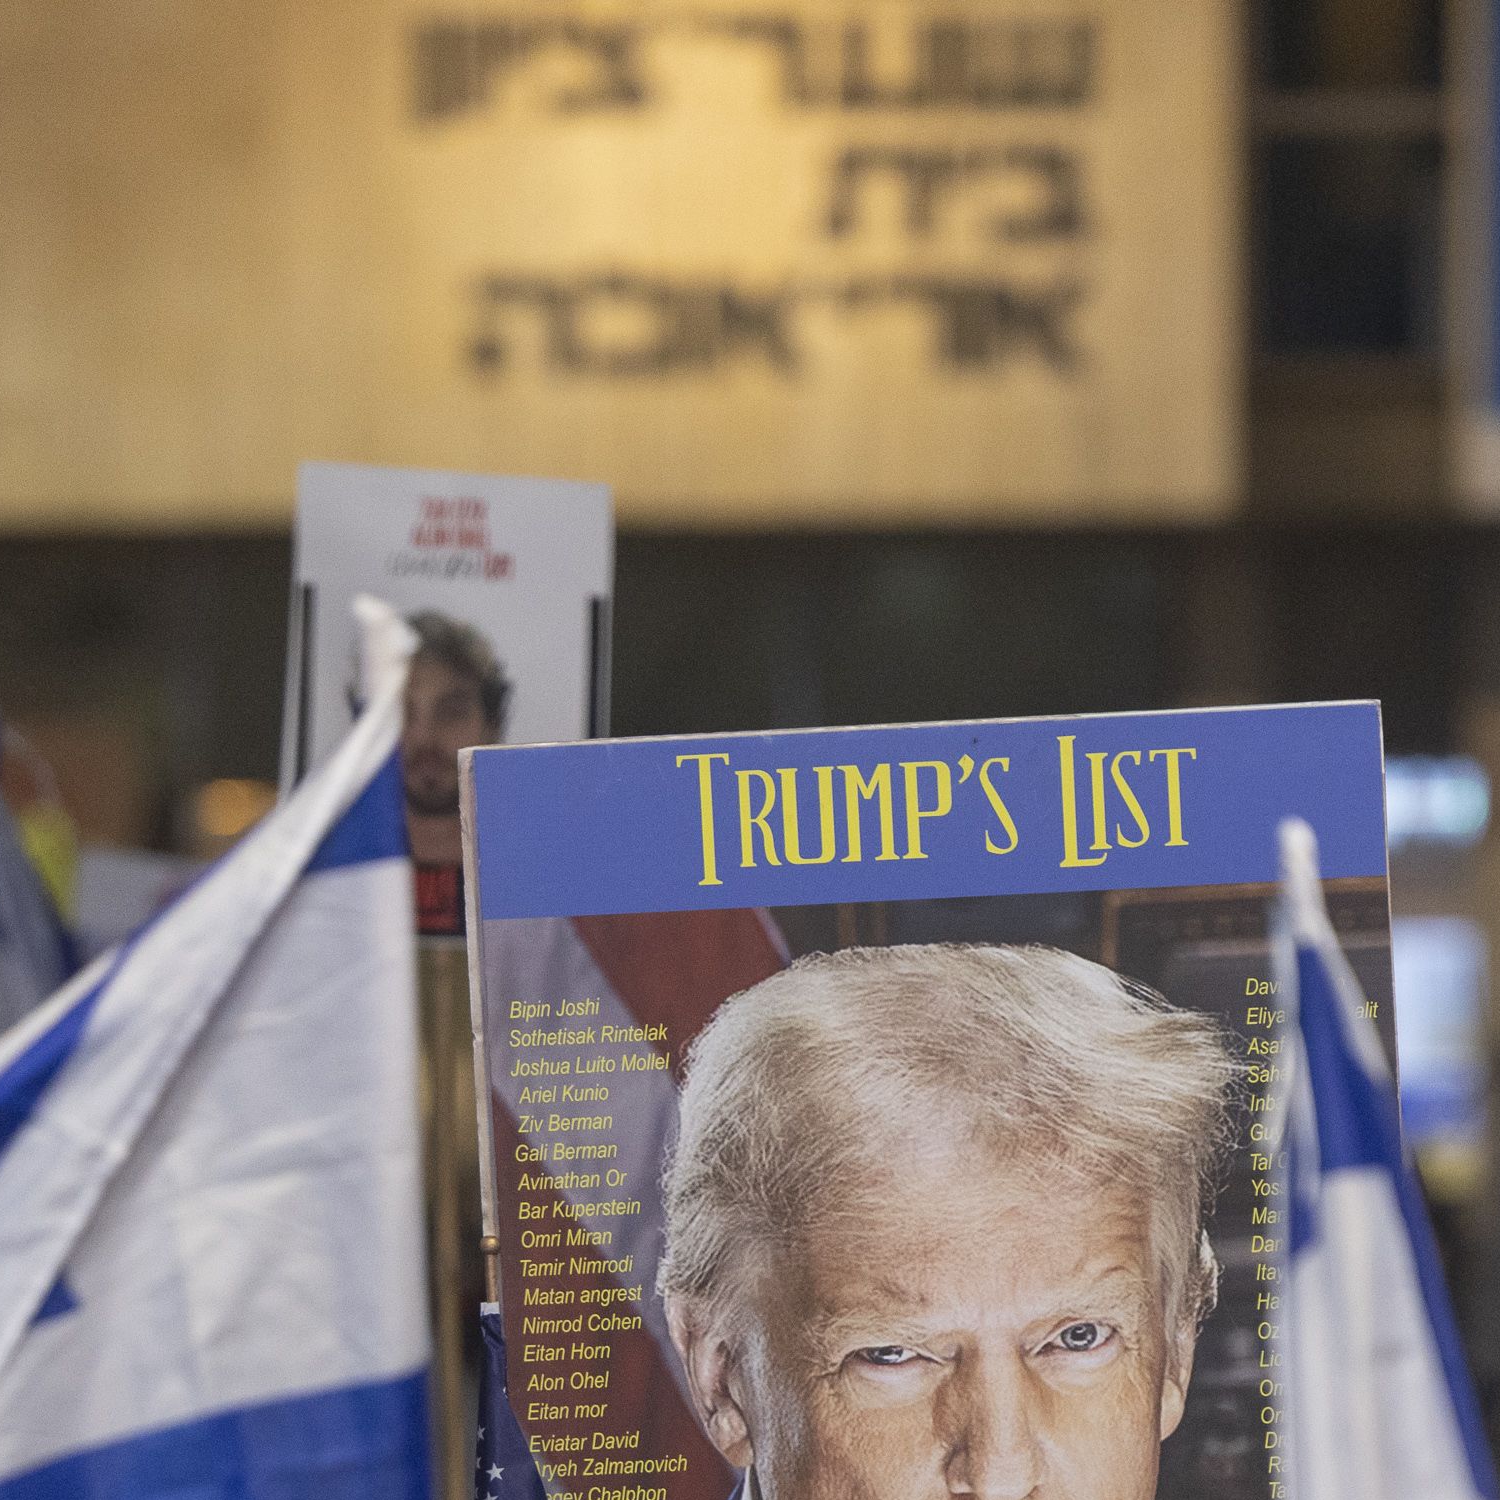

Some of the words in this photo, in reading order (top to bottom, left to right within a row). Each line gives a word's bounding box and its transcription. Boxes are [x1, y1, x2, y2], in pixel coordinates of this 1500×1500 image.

[1246, 977, 1279, 996] Dav
[510, 1001, 551, 1022] Bipin
[556, 998, 600, 1017] Joshi
[1246, 1007, 1285, 1029] Eliya
[509, 1027, 595, 1047] Sothetisak
[601, 1023, 668, 1043] Rintelak
[510, 1057, 570, 1077] Joshua
[621, 1052, 670, 1072] Mollel
[519, 1086, 556, 1104] Ariel
[562, 1084, 609, 1102] Kunio
[518, 1115, 543, 1133] Ziv
[548, 1114, 613, 1132] Berman
[515, 1144, 547, 1162] Gali
[553, 1142, 617, 1160] Berman
[1251, 1153, 1272, 1171] Tal
[518, 1173, 600, 1191] Avinathan
[606, 1169, 627, 1187] Or
[518, 1202, 547, 1220] Bar
[552, 1197, 641, 1222] Kuperstein
[521, 1230, 561, 1248] Omri
[566, 1228, 613, 1246] Miran
[520, 1259, 565, 1277] Tamir
[569, 1255, 633, 1275] Nimrodi
[524, 1288, 574, 1306] Matan
[580, 1285, 642, 1307] angrest
[523, 1315, 582, 1334] Nimrod
[588, 1313, 641, 1331] Cohen
[523, 1344, 565, 1362] Eitan
[571, 1342, 610, 1360] Horn
[527, 1374, 564, 1391] Alon
[570, 1371, 609, 1389] Ohel
[528, 1403, 569, 1421] Eitan
[575, 1403, 607, 1419] mor
[529, 1434, 587, 1452] Eviatar
[592, 1431, 639, 1449] David
[583, 1455, 687, 1476] Zalmanovich
